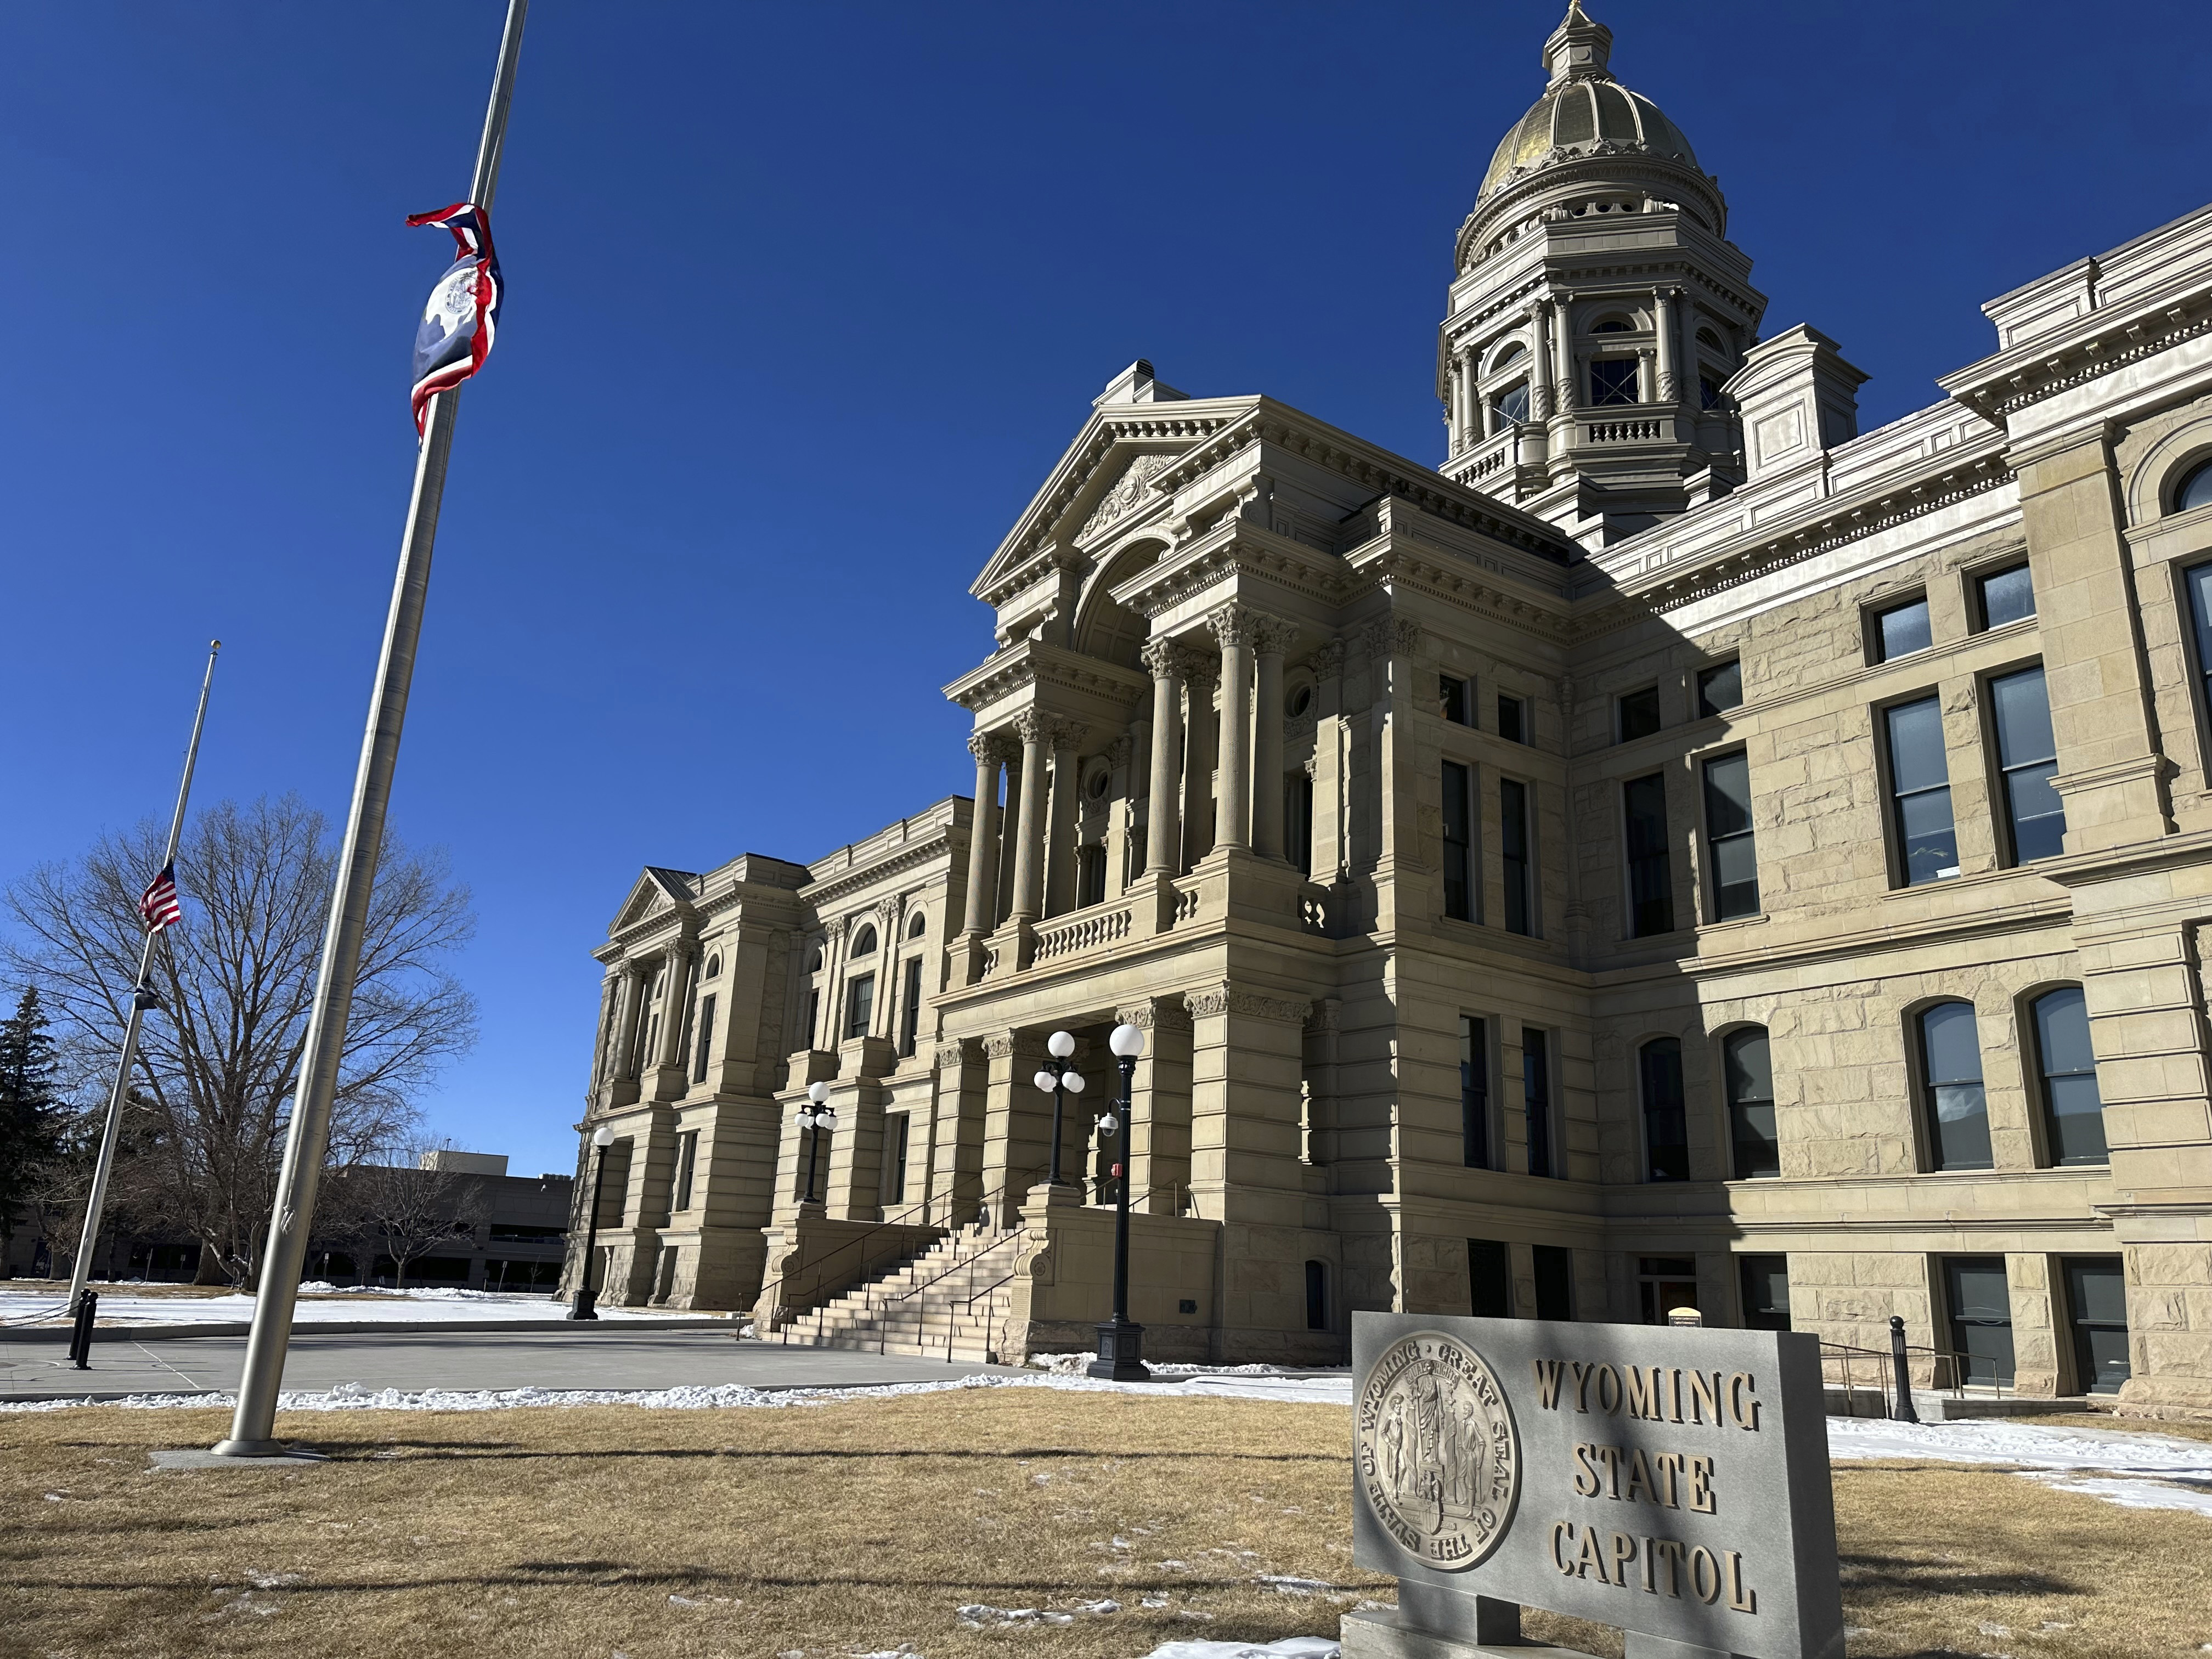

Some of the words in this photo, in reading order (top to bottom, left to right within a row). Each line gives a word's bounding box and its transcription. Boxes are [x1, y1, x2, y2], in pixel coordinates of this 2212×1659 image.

[1361, 1340, 1421, 1432] WYOMING
[1434, 1362, 1459, 1385] RIGHTS
[1438, 1343, 1499, 1407] GREAT
[1530, 1358, 1762, 1432] WYOMING
[1362, 1442, 1376, 1476] OF
[1492, 1421, 1510, 1501] SEAL
[1572, 1442, 1717, 1515] STATE
[1369, 1480, 1421, 1553] STATE
[1430, 1533, 1473, 1561] THE
[1474, 1508, 1497, 1545] OF
[1549, 1521, 1757, 1615] CAPITOL
